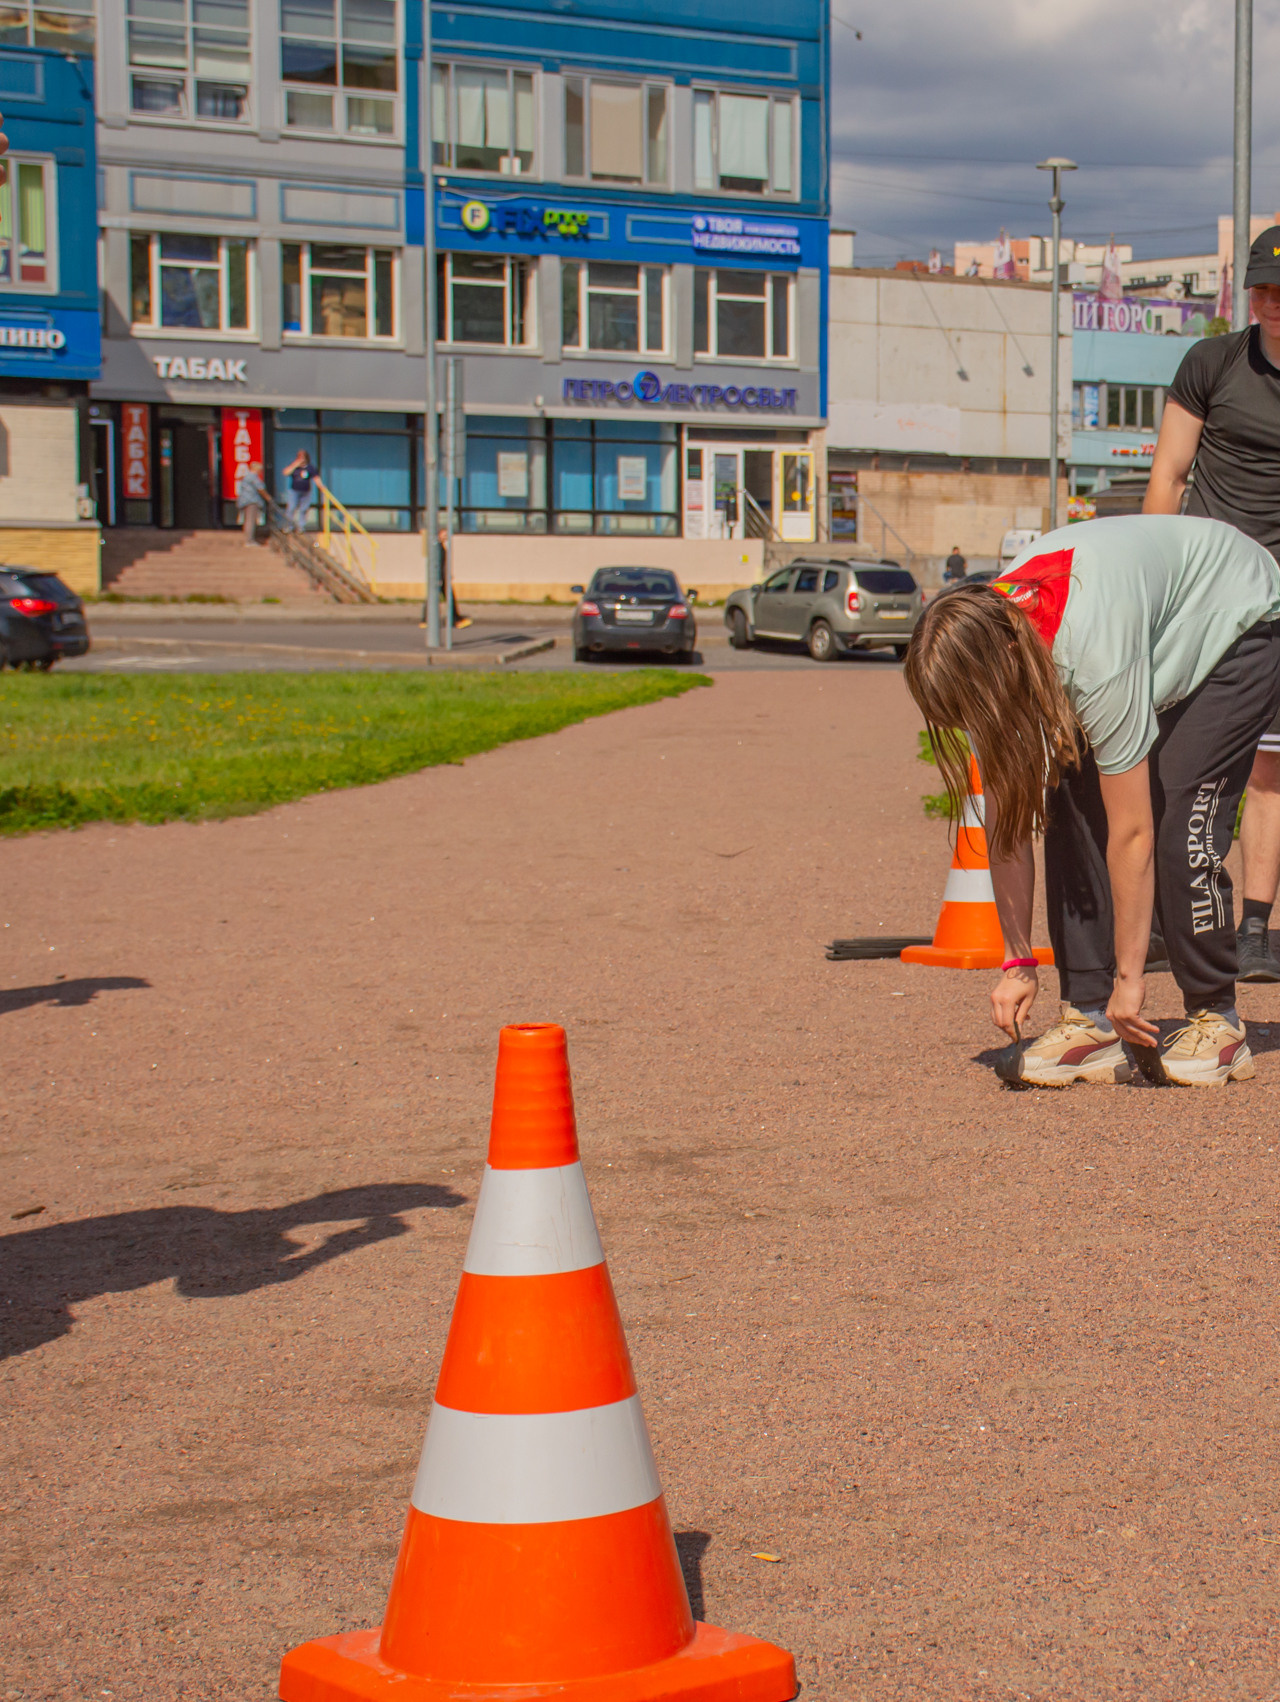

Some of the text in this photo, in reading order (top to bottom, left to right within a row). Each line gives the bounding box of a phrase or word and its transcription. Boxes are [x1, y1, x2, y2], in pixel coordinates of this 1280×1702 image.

[707, 216, 743, 234] ТВОЯ
[692, 233, 801, 255] НЕДВИЖИМОСТЬ
[153, 355, 249, 381] ТАБАК
[127, 407, 147, 495] ТАБАК
[1187, 781, 1218, 936] FILA SPORT
